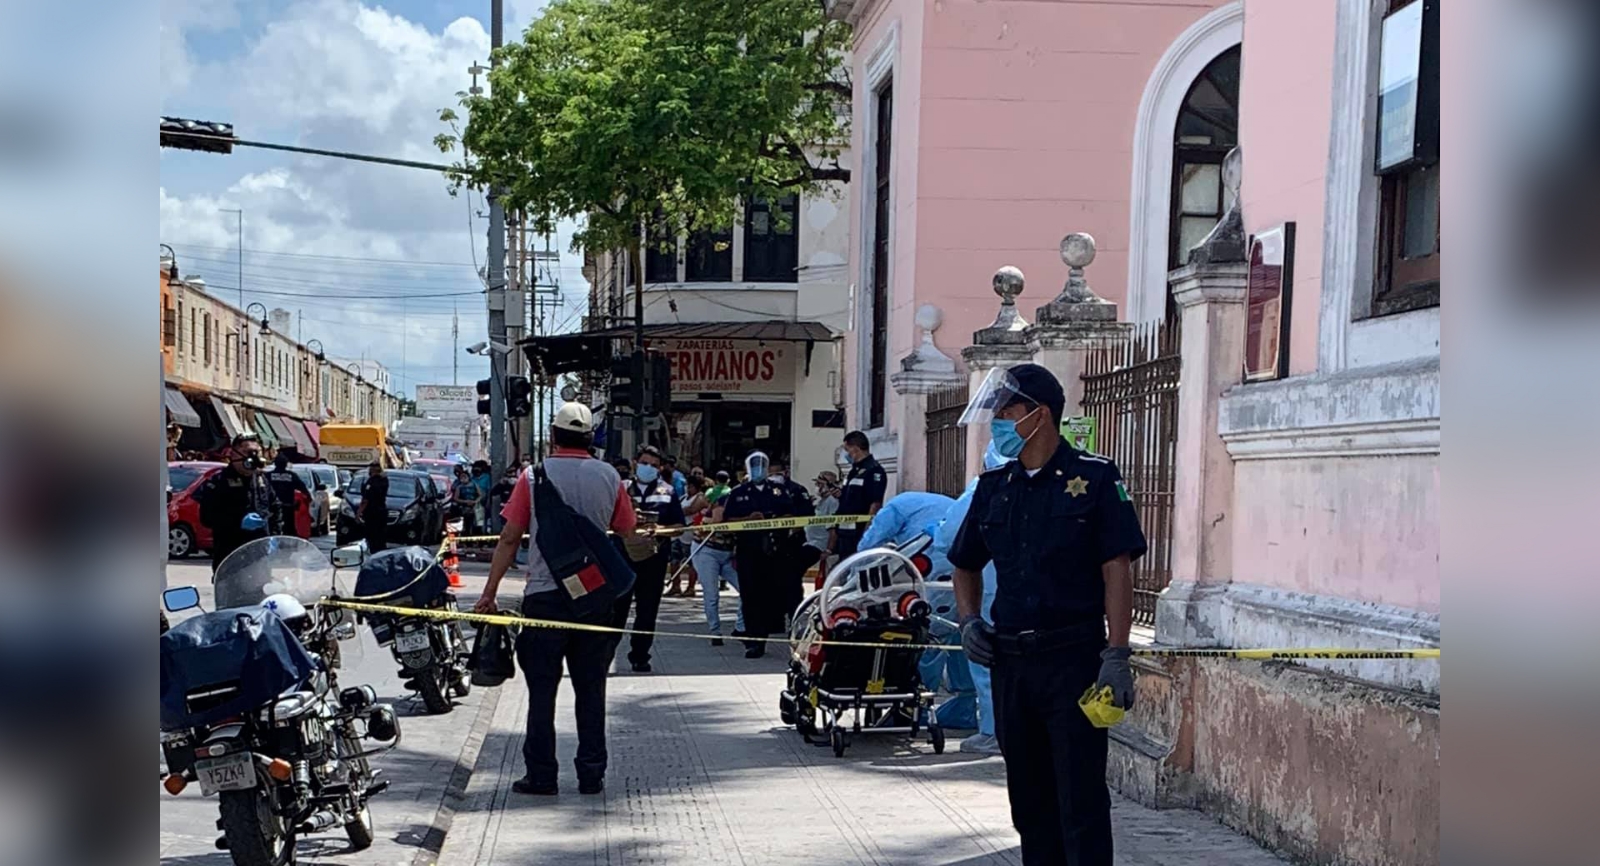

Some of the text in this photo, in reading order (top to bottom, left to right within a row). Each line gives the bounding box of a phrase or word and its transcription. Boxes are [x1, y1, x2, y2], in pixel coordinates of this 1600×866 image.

[676, 340, 734, 350] ZAPATERIAS
[665, 350, 774, 381] ERMANOS
[206, 761, 246, 785] Y5ZK4
